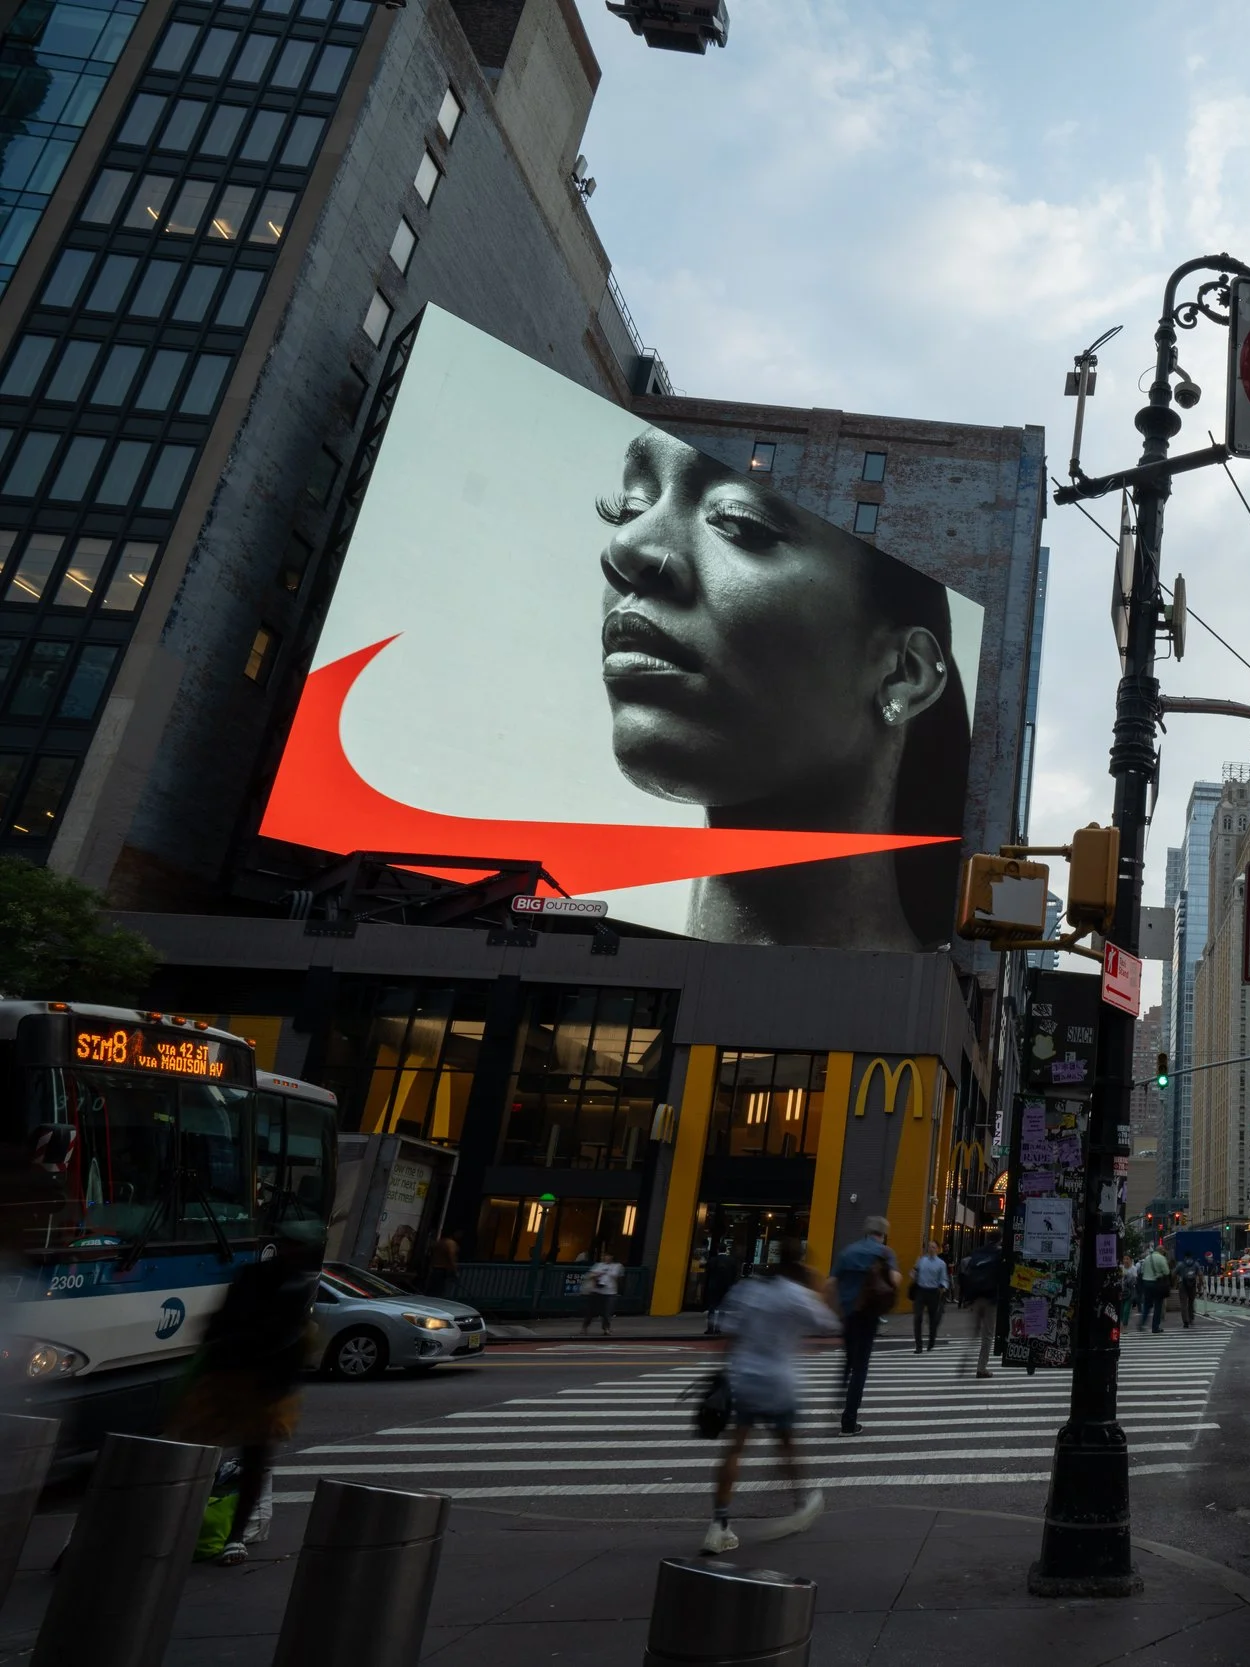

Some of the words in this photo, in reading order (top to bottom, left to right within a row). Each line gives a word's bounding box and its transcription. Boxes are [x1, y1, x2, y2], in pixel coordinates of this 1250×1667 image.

[517, 898, 541, 910] BIG
[546, 902, 602, 912] OUTDOOR
[77, 1030, 128, 1063] SIM8
[158, 1044, 176, 1056] VIA
[179, 1043, 193, 1058] 42
[196, 1046, 208, 1060] ST
[139, 1056, 158, 1068] VIA
[161, 1057, 207, 1076] MADISON
[209, 1062, 223, 1078] AV
[50, 1274, 84, 1290] 2300
[156, 1306, 181, 1331] MTA
